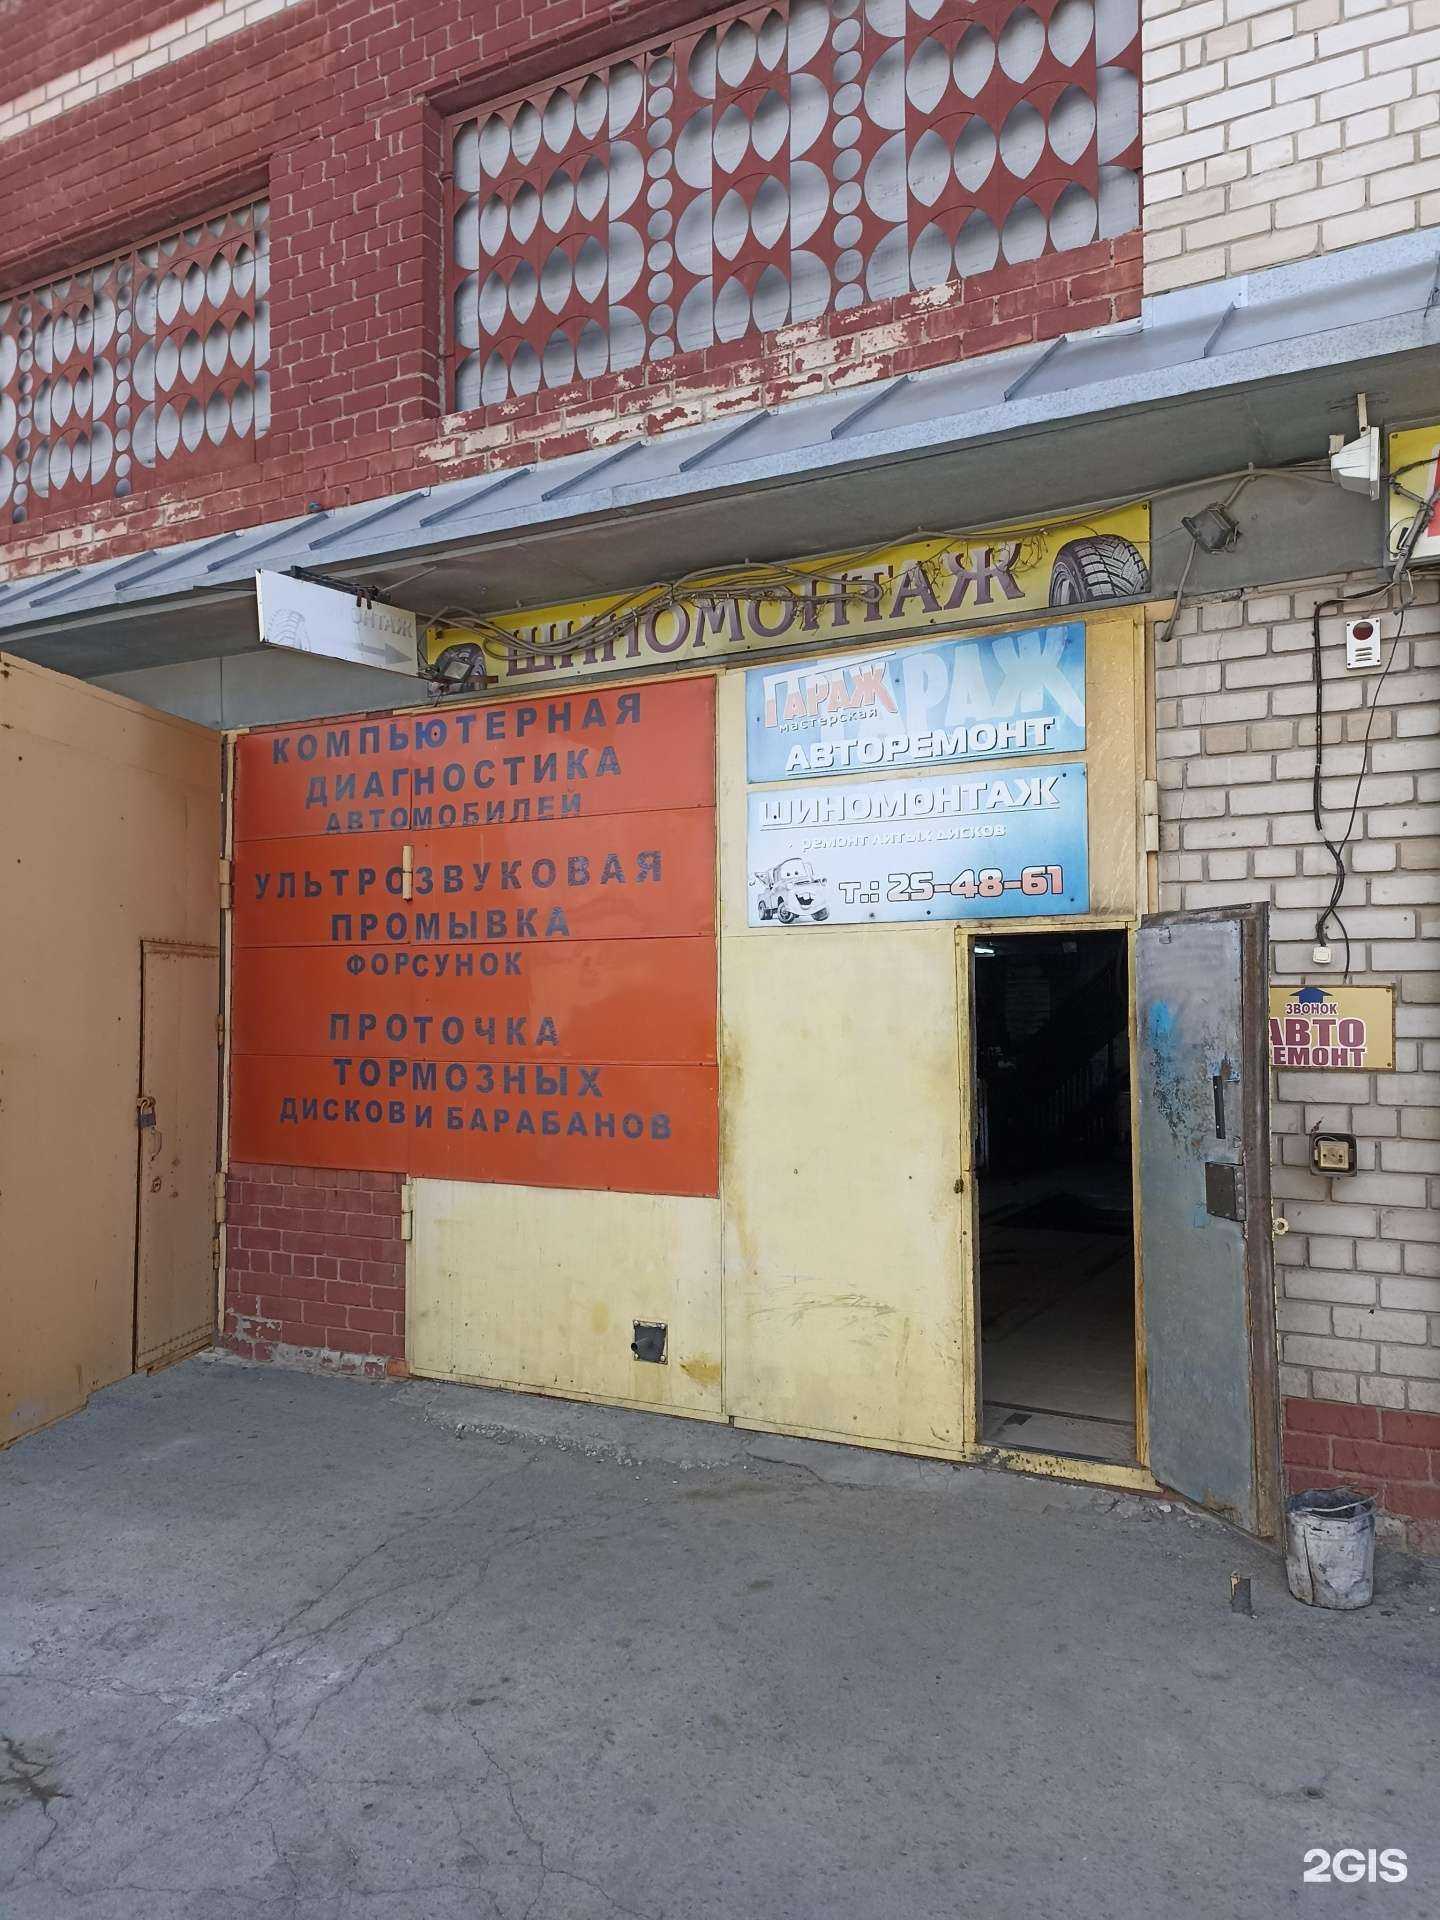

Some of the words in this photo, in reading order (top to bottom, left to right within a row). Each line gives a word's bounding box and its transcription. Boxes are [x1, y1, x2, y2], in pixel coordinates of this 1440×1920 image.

[504, 543, 1026, 678] ШИНОМОНТАЖ
[763, 650, 899, 728] ГАРАЖ
[272, 692, 642, 764] КОМПЬЮТЕРНАЯ
[778, 707, 878, 734] мастерская
[784, 717, 1057, 773] АВТОРЕМОНТ
[305, 745, 622, 809] ДИАГНОСТИКА
[326, 788, 582, 834] АВТОМОБИЛЕЙ
[760, 775, 1061, 826] ШИНОМОНТАЖ
[255, 850, 664, 901] УЛЬТРОЗВУКОВАЯ
[886, 864, 1064, 903] 25-48-61
[331, 907, 571, 942] ПРОМЫВКА
[346, 951, 523, 977] ФОРСУНОК
[329, 1013, 560, 1047] ПРОТОЧКА
[1285, 1002, 1338, 1016] ЗВОНОК
[1271, 1046, 1367, 1067] ЕМОНТ
[333, 1057, 604, 1099] ТОРМОЗНЫХ
[446, 1106, 672, 1141] БАРАБАНОВ
